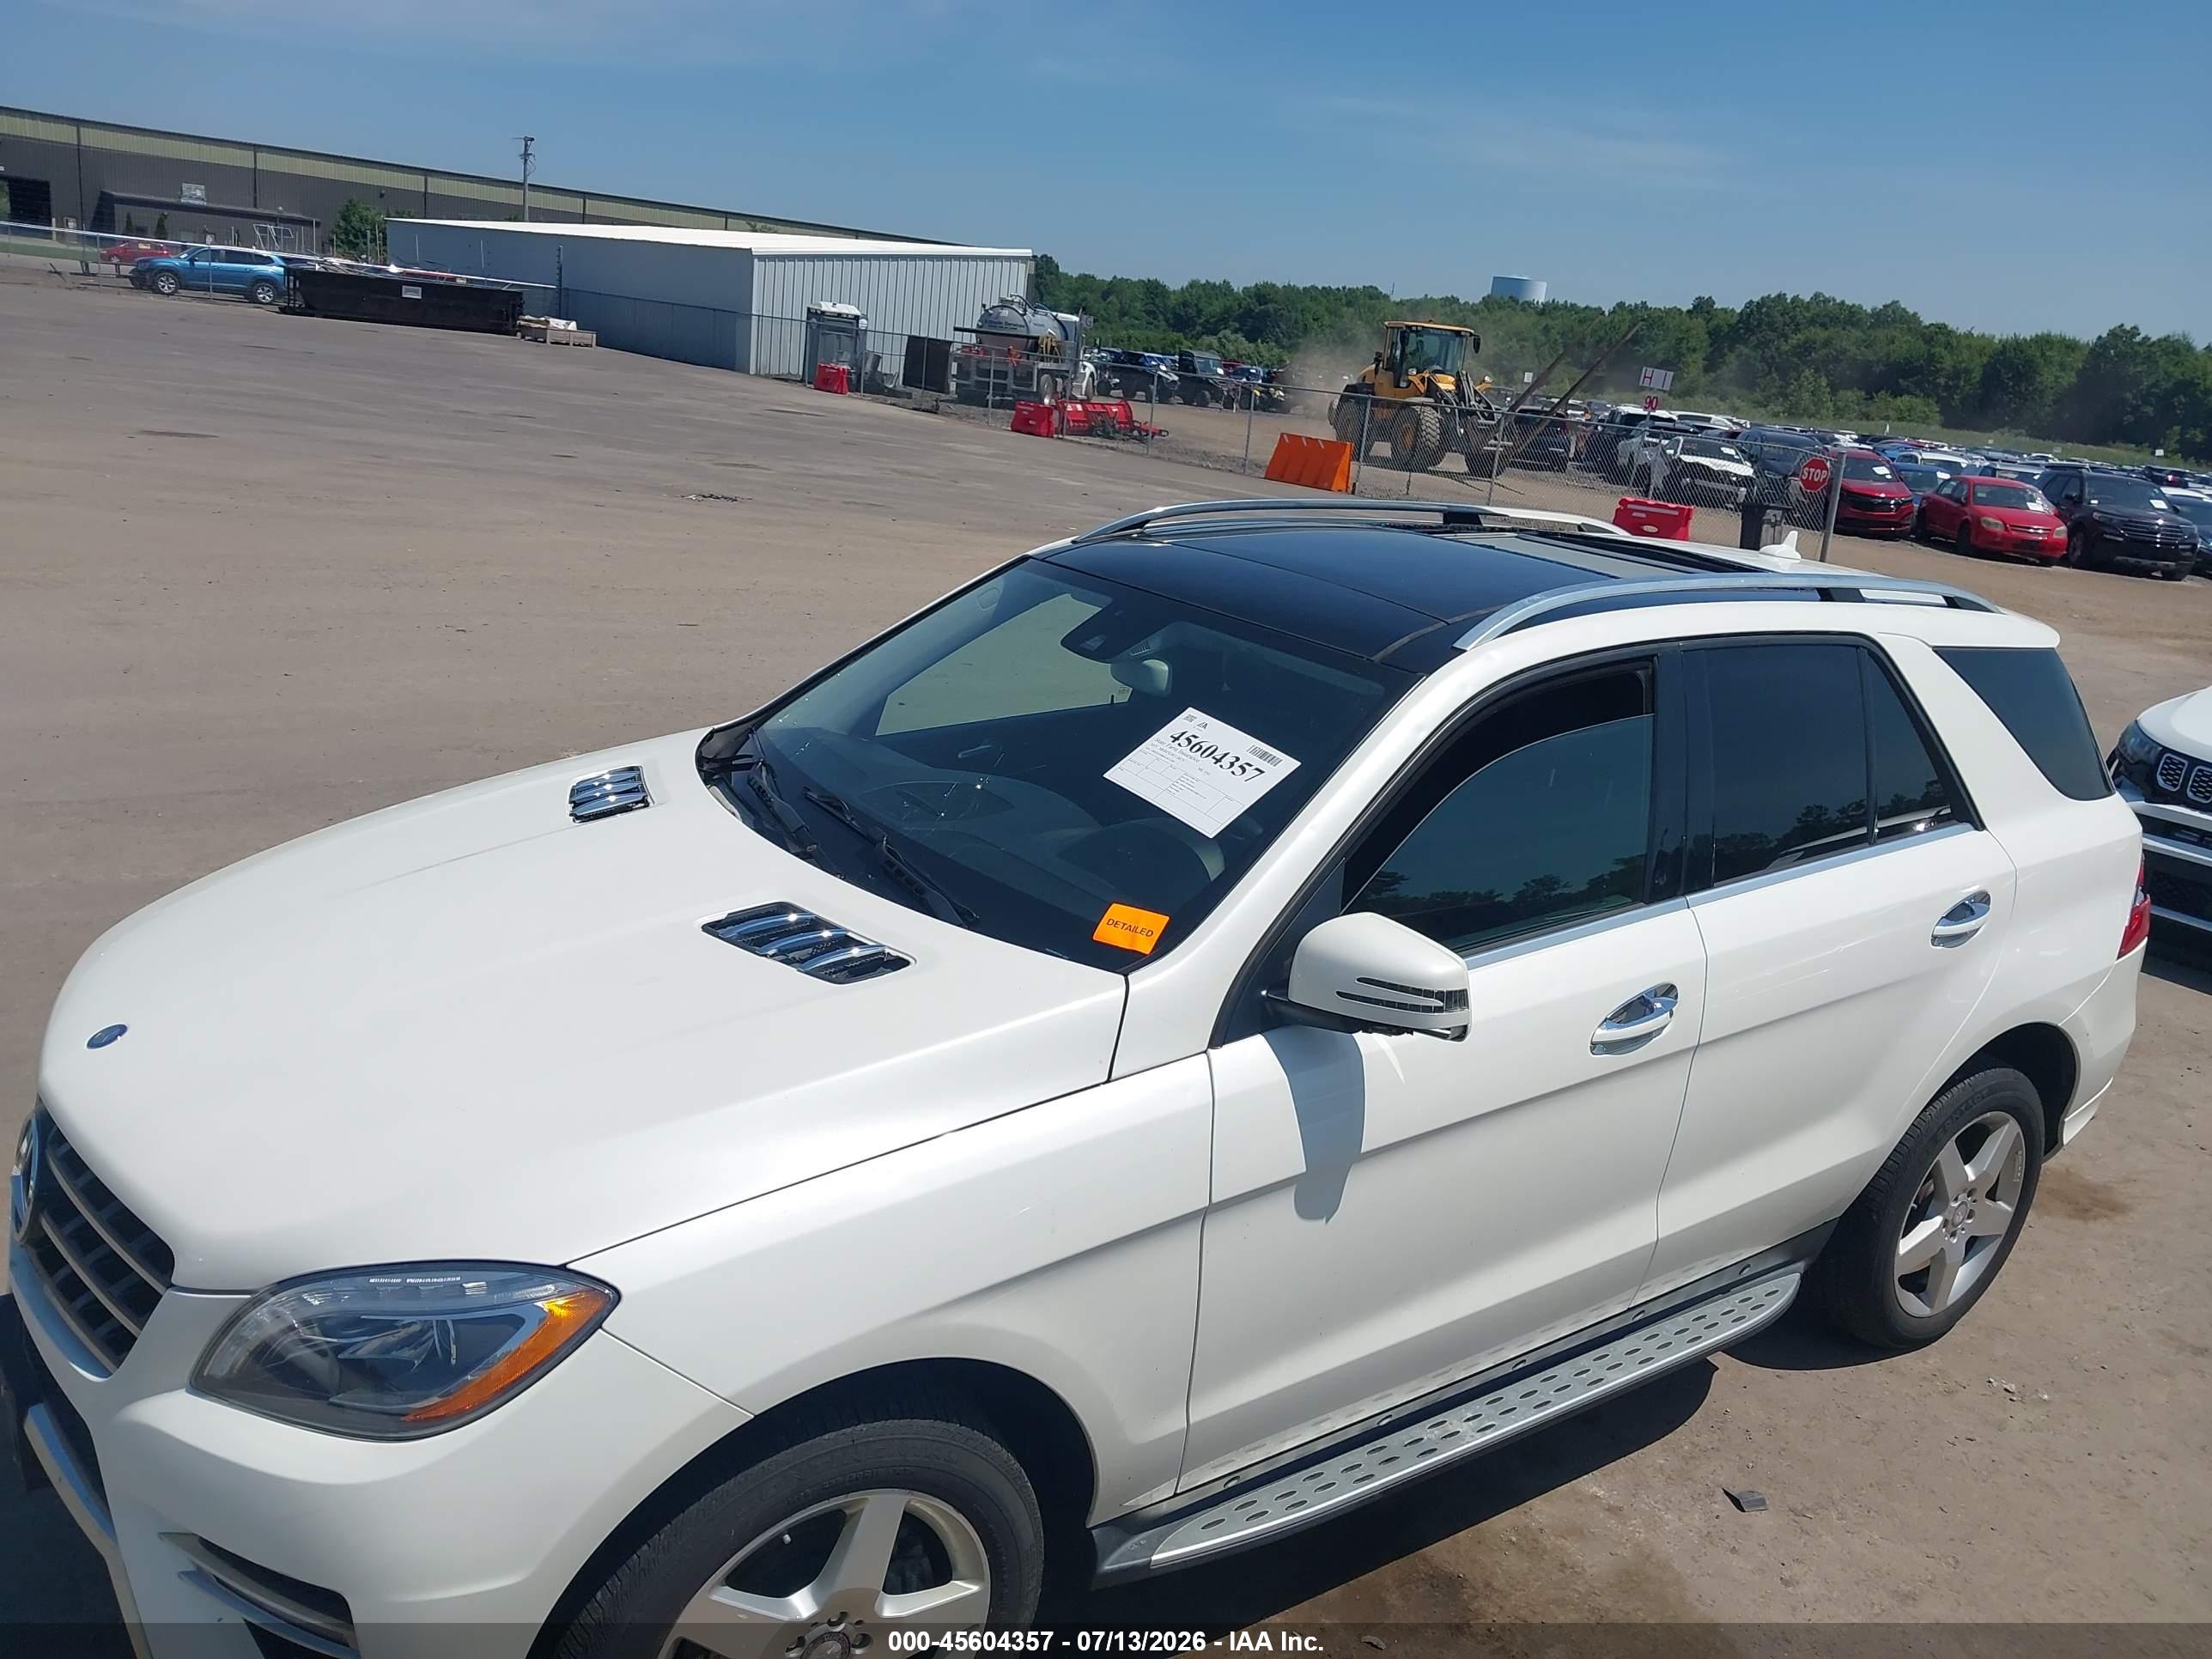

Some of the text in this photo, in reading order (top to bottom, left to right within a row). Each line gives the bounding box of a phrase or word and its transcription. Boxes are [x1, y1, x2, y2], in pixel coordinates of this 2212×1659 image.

[1644, 396, 1658, 410] 90
[1802, 467, 1828, 483] STOP
[1170, 731, 1266, 781] 45604357
[1106, 918, 1154, 937] DETAILED
